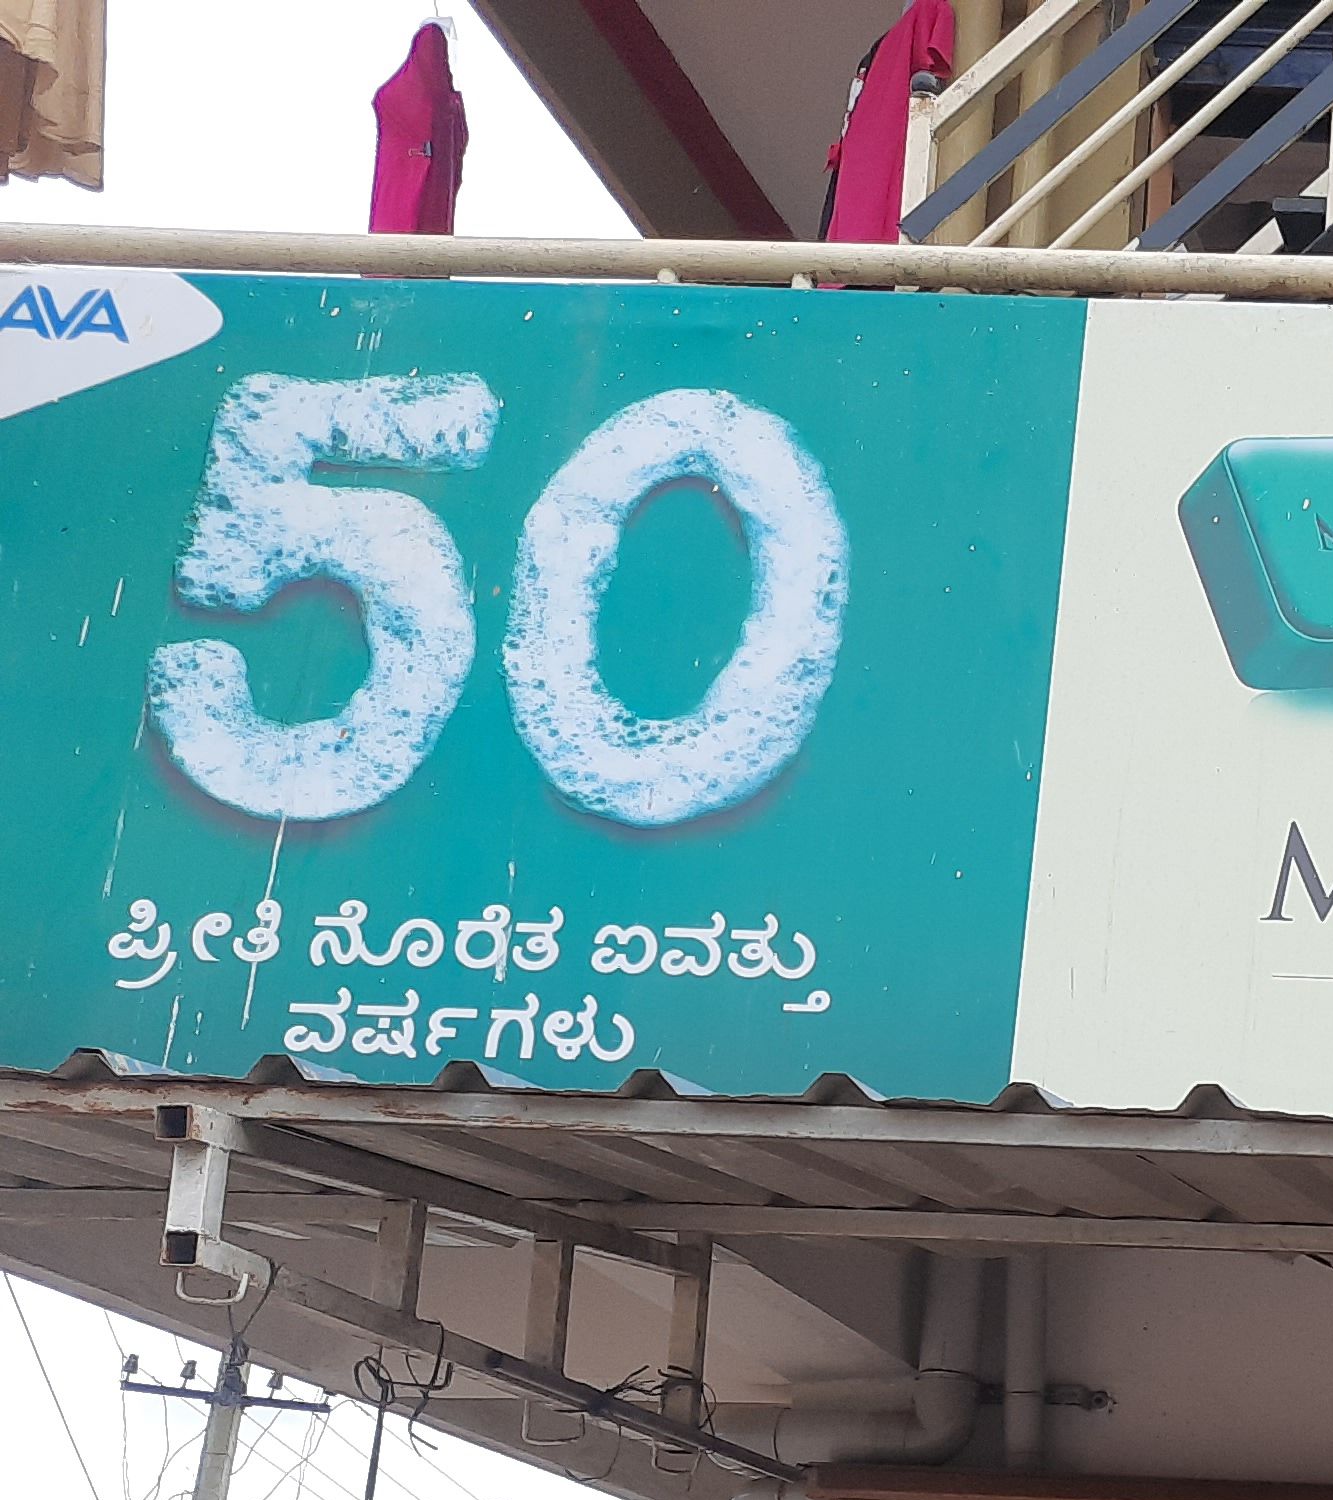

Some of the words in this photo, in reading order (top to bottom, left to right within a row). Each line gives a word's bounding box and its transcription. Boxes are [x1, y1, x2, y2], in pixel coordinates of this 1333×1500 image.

[148, 371, 851, 827] 50
[107, 898, 283, 989] ಪ್ರೀತಿ
[591, 911, 833, 1013] ಐವತ್ತು
[283, 988, 636, 1062] ವರ್ಷಗಳು
